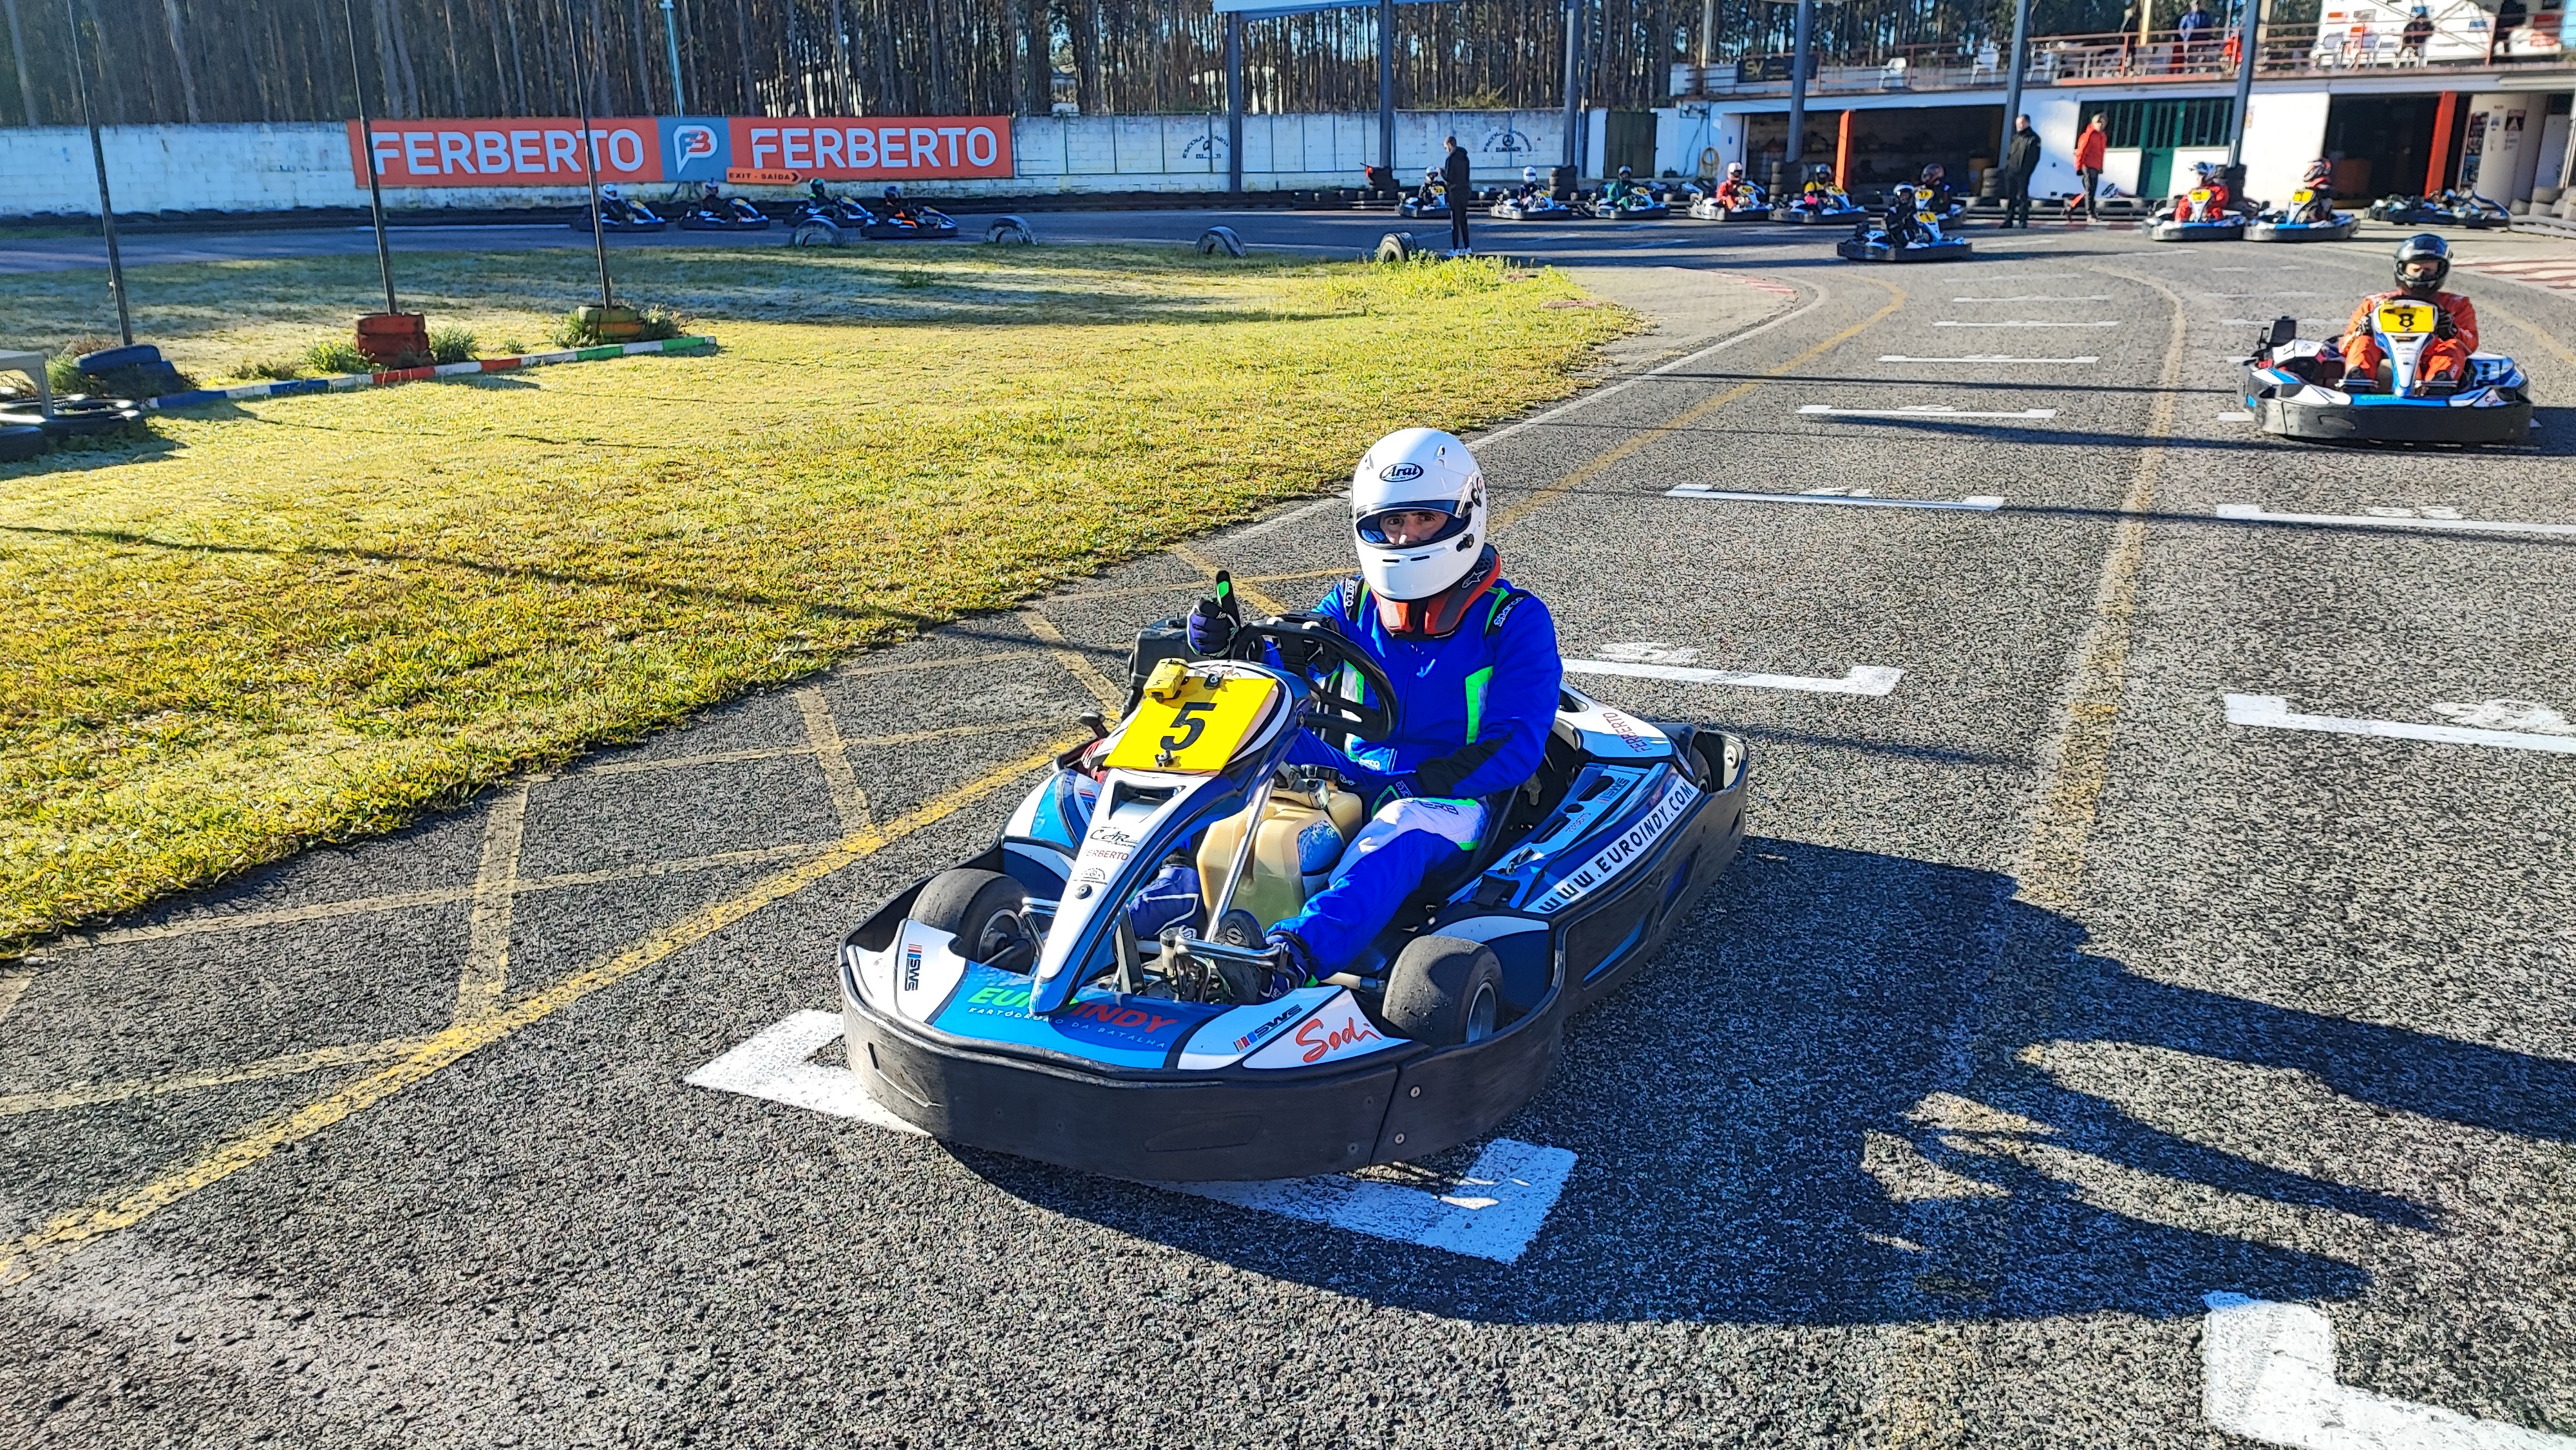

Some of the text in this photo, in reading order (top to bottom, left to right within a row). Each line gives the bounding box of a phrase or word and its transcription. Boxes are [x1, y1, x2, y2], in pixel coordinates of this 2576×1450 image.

[371, 129, 644, 174] FERBERTO
[750, 126, 998, 169] FERBERTO
[2399, 313, 2414, 328] 8
[1382, 465, 1419, 478] Arai
[1160, 701, 1218, 751] 5
[1602, 712, 1653, 753] FERBERTO
[1085, 849, 1130, 861] ERBERTO
[1539, 781, 1694, 912] WWW.EUROINDY.COM
[967, 986, 1179, 1034] EUINDY
[1071, 1021, 1090, 1030] DA
[1097, 1027, 1166, 1049] BATALHA
[1296, 1017, 1382, 1063] Sodi
